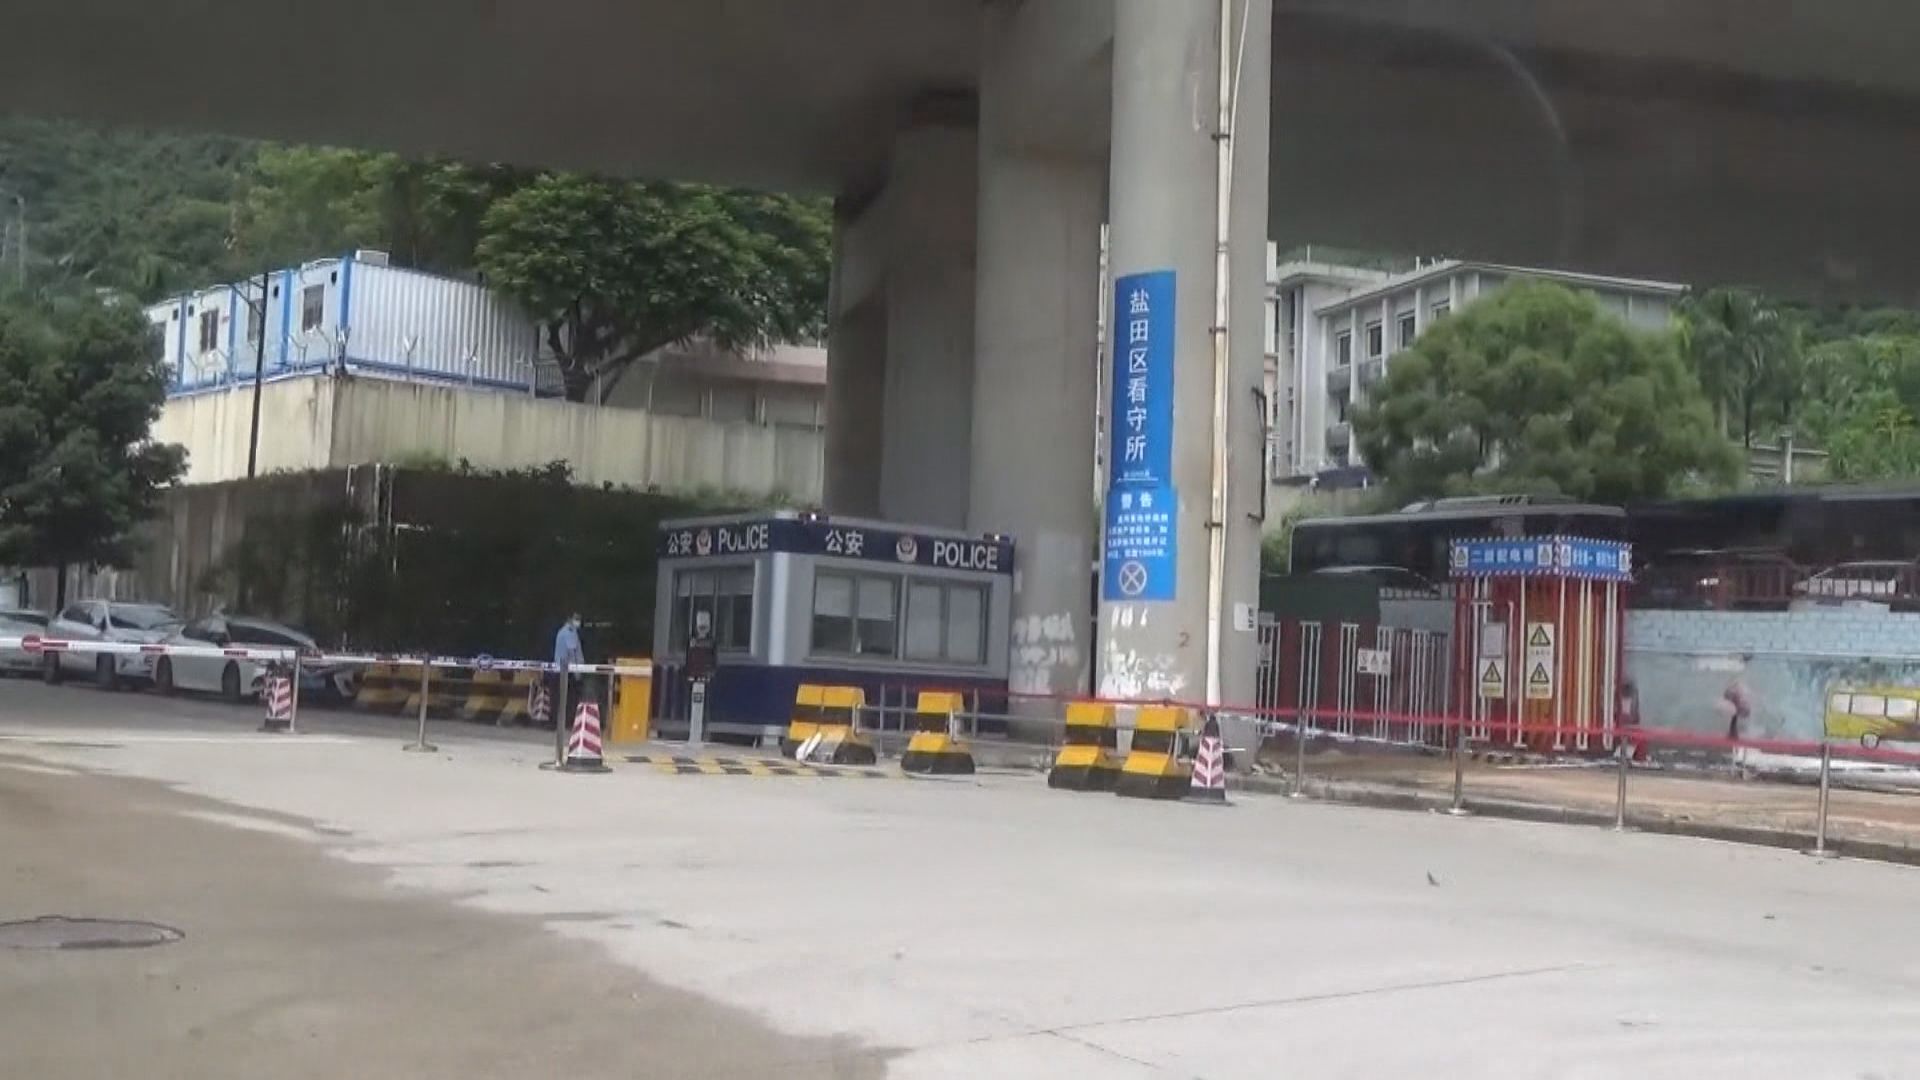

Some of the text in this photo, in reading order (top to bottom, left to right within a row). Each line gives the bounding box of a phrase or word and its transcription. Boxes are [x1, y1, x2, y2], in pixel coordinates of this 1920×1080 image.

[1125, 288, 1150, 462] 盐田区看守所
[666, 534, 692, 554] 公安
[717, 524, 769, 552] POLICE
[825, 529, 864, 556] 公安
[932, 541, 998, 570] POLICE
